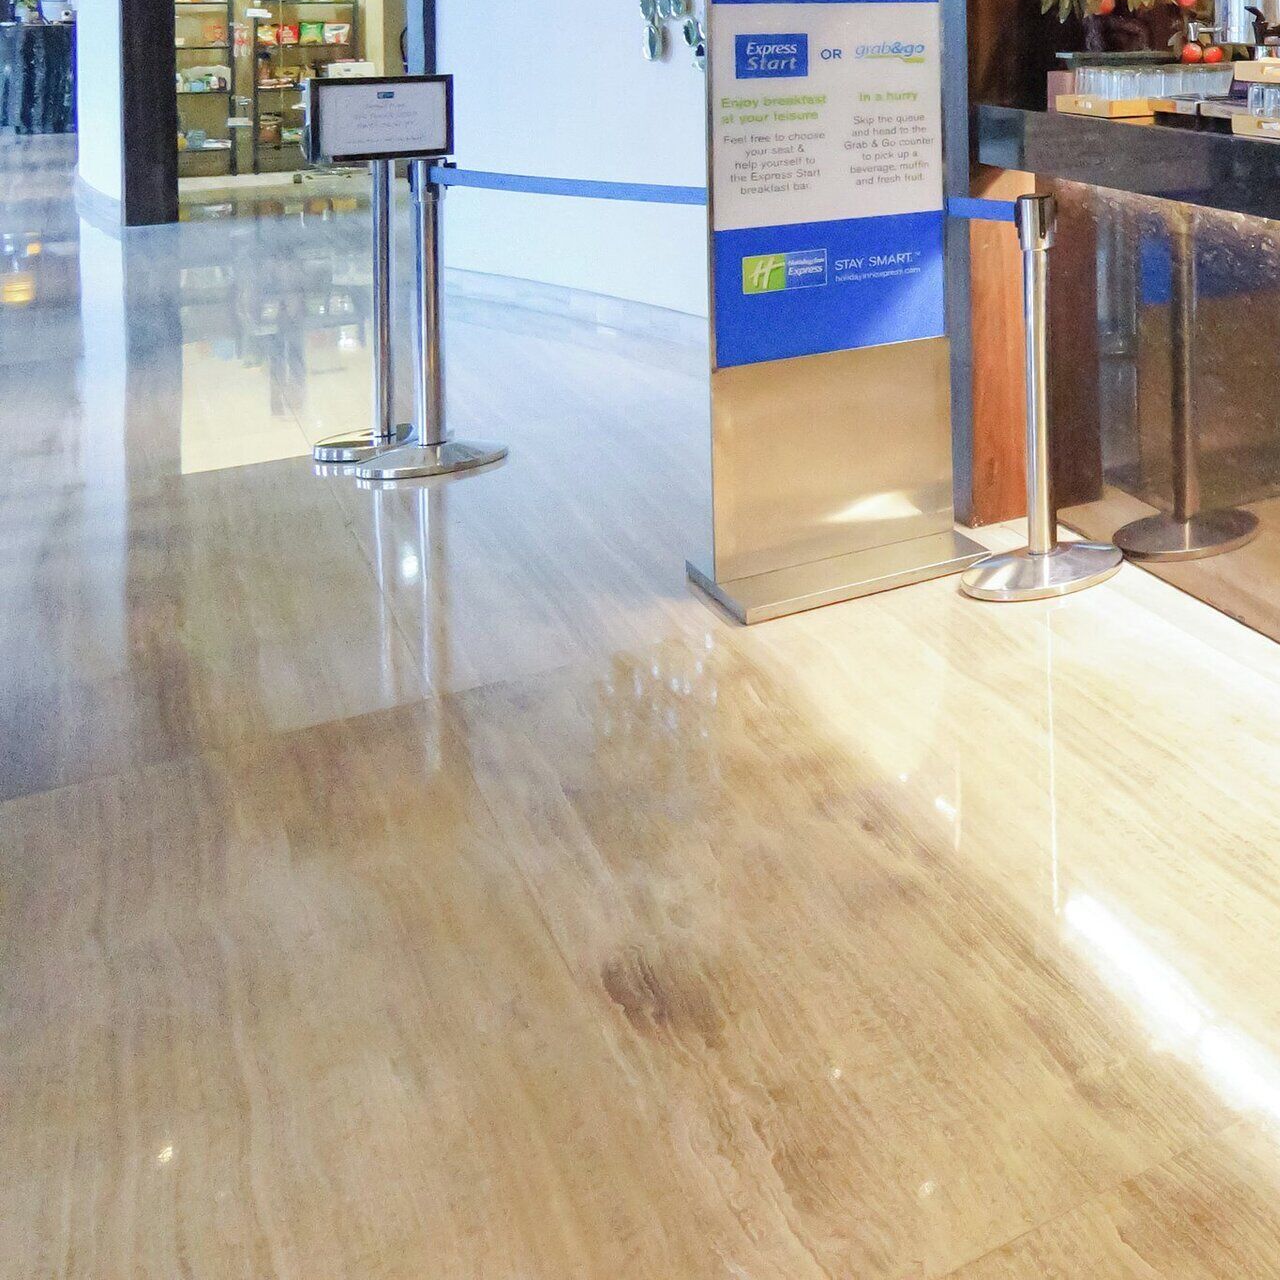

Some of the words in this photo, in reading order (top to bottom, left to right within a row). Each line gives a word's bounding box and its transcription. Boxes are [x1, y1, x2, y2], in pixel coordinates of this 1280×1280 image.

[746, 41, 798, 59] Express
[820, 48, 842, 60] OR
[855, 41, 926, 59] grab&go
[746, 55, 797, 71] Start
[721, 96, 759, 111] Enjoy
[763, 94, 828, 107] breakfast
[859, 92, 871, 102] In
[886, 91, 919, 103] hurry
[738, 113, 770, 126] your
[773, 109, 820, 122] leisure
[853, 115, 875, 126] Skip
[877, 113, 893, 123] the
[895, 113, 925, 125] queue
[723, 134, 748, 145] Feel
[750, 132, 771, 144] free
[774, 131, 786, 142] to
[788, 130, 826, 141] choose
[851, 128, 870, 138] and
[872, 126, 898, 136] head
[900, 125, 909, 134] to
[911, 124, 927, 134] the
[745, 147, 769, 158] your
[771, 145, 795, 156] seat
[797, 143, 805, 153] &
[843, 139, 868, 151] Grab
[871, 138, 879, 149] &
[881, 138, 897, 148] Go
[899, 136, 935, 147] counter
[734, 158, 759, 172] help
[761, 156, 803, 170] yourself
[805, 156, 816, 166] to
[862, 151, 872, 161] to
[874, 150, 896, 163] pick
[898, 150, 910, 162] up
[899, 159, 930, 170] muffin
[730, 173, 748, 183] the
[750, 170, 793, 183] Express
[796, 168, 821, 179] Start
[855, 175, 875, 185] and
[877, 173, 901, 184] fresh
[740, 182, 791, 195] breakfast
[834, 257, 865, 271] STAY
